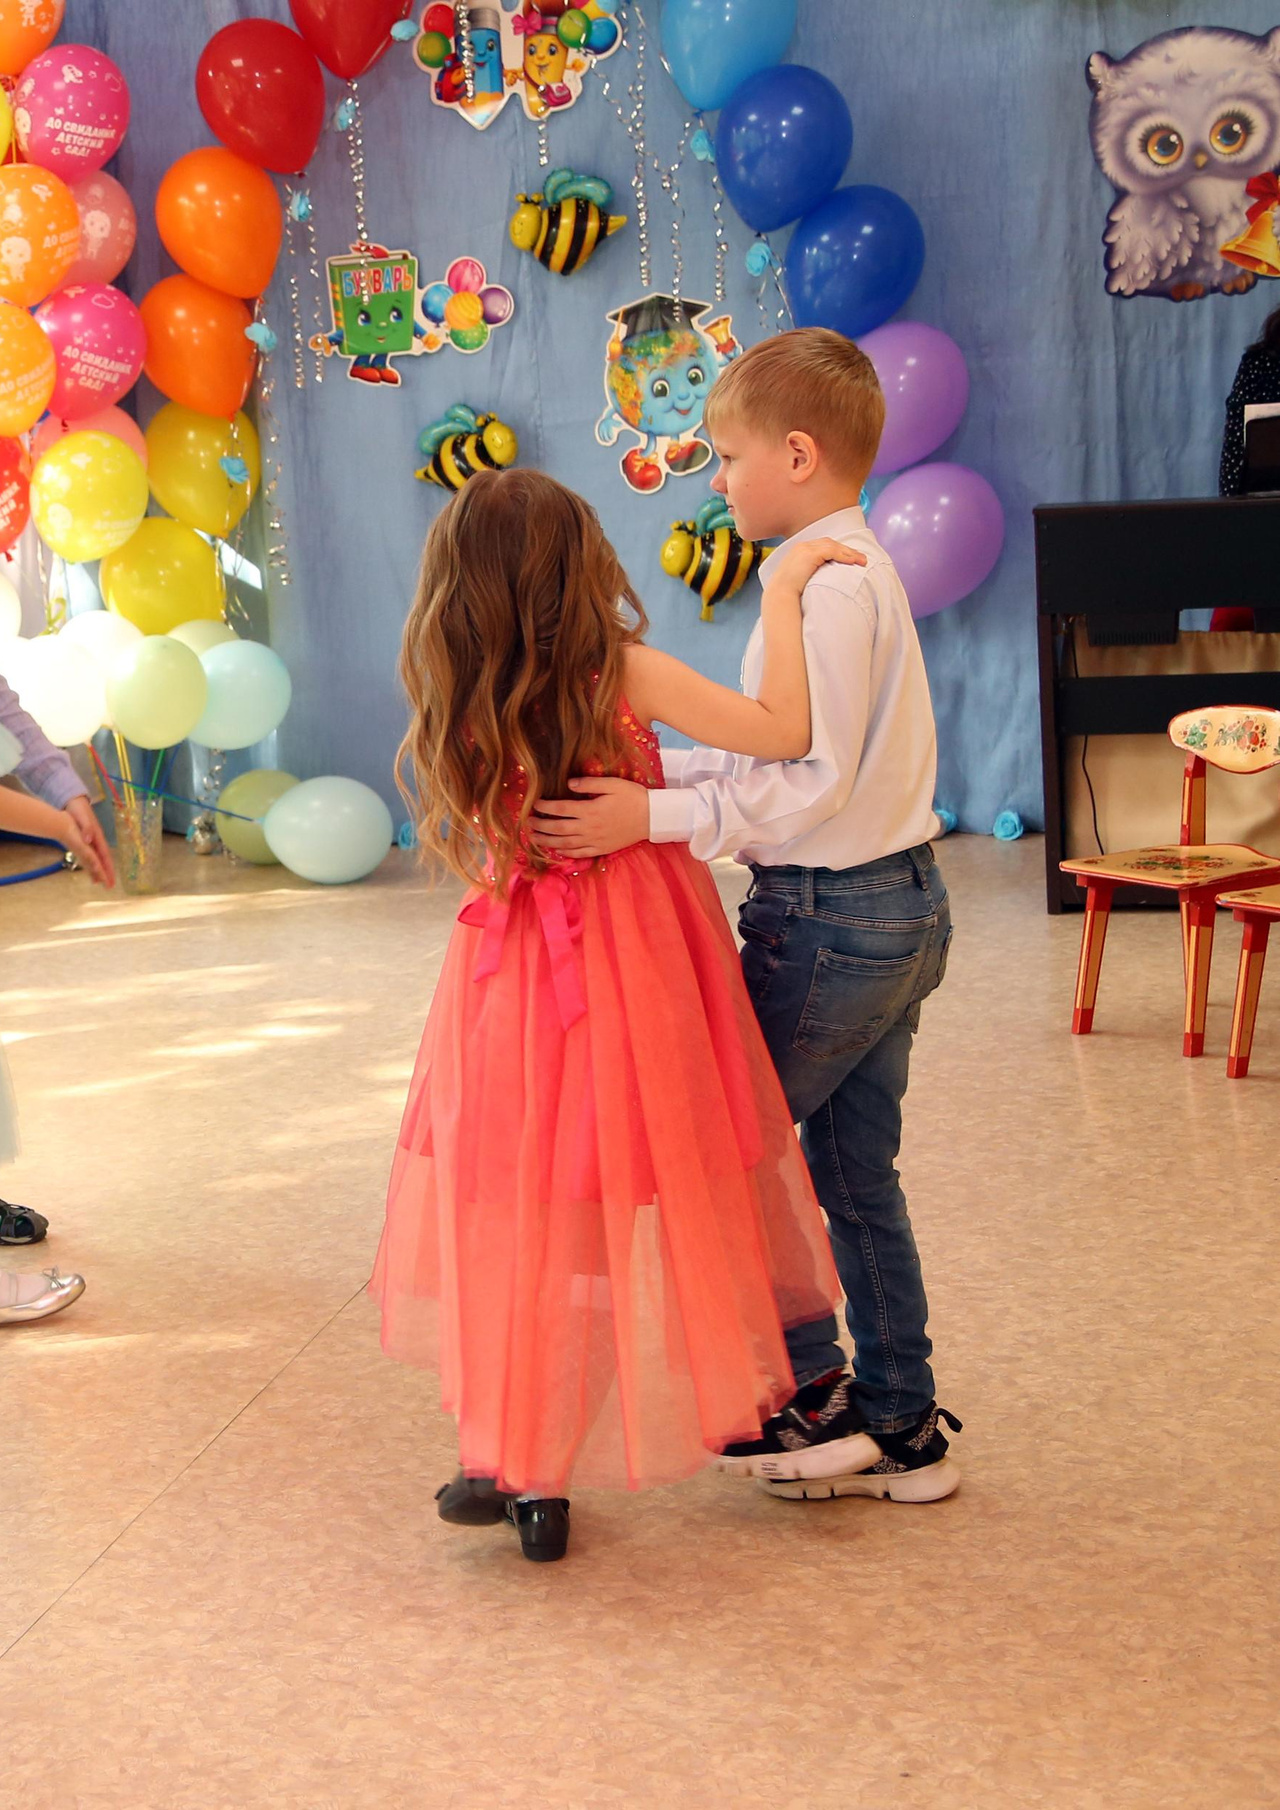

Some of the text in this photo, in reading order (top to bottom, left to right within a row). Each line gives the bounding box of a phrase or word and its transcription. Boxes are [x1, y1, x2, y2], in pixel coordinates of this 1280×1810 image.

[45, 116, 63, 130] ДО
[55, 131, 105, 149] ДЕТСКИЙ
[62, 345, 80, 359] ДО
[70, 361, 120, 384] ДЕТСКИЙ
